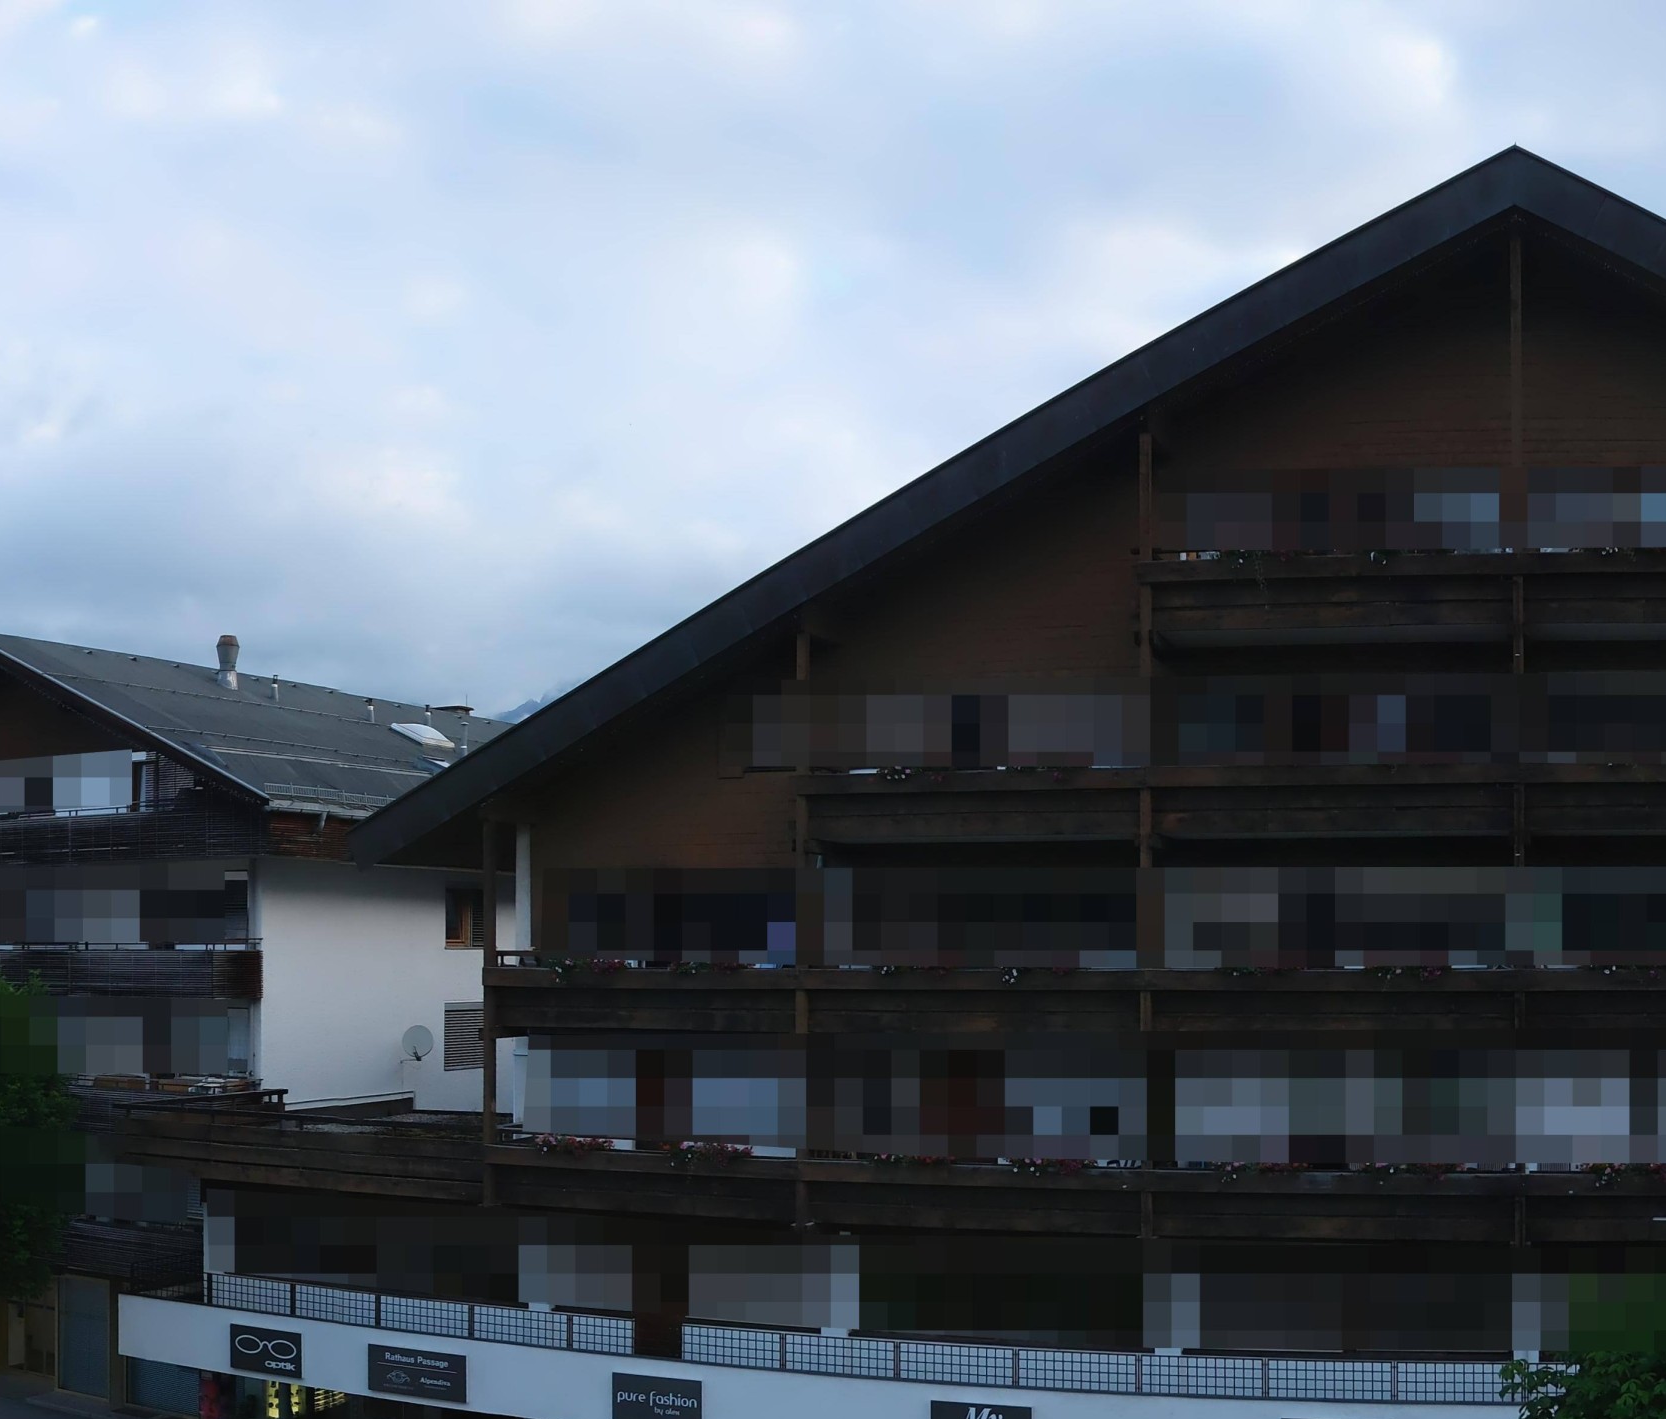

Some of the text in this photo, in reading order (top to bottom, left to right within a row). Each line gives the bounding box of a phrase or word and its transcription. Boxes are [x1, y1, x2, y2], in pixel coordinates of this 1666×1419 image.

[265, 1360, 296, 1371] optik
[385, 1352, 449, 1369] Rathaus Passage
[419, 1377, 451, 1387] Alpendiva
[617, 1391, 697, 1408] pure fashion
[654, 1406, 664, 1415] by
